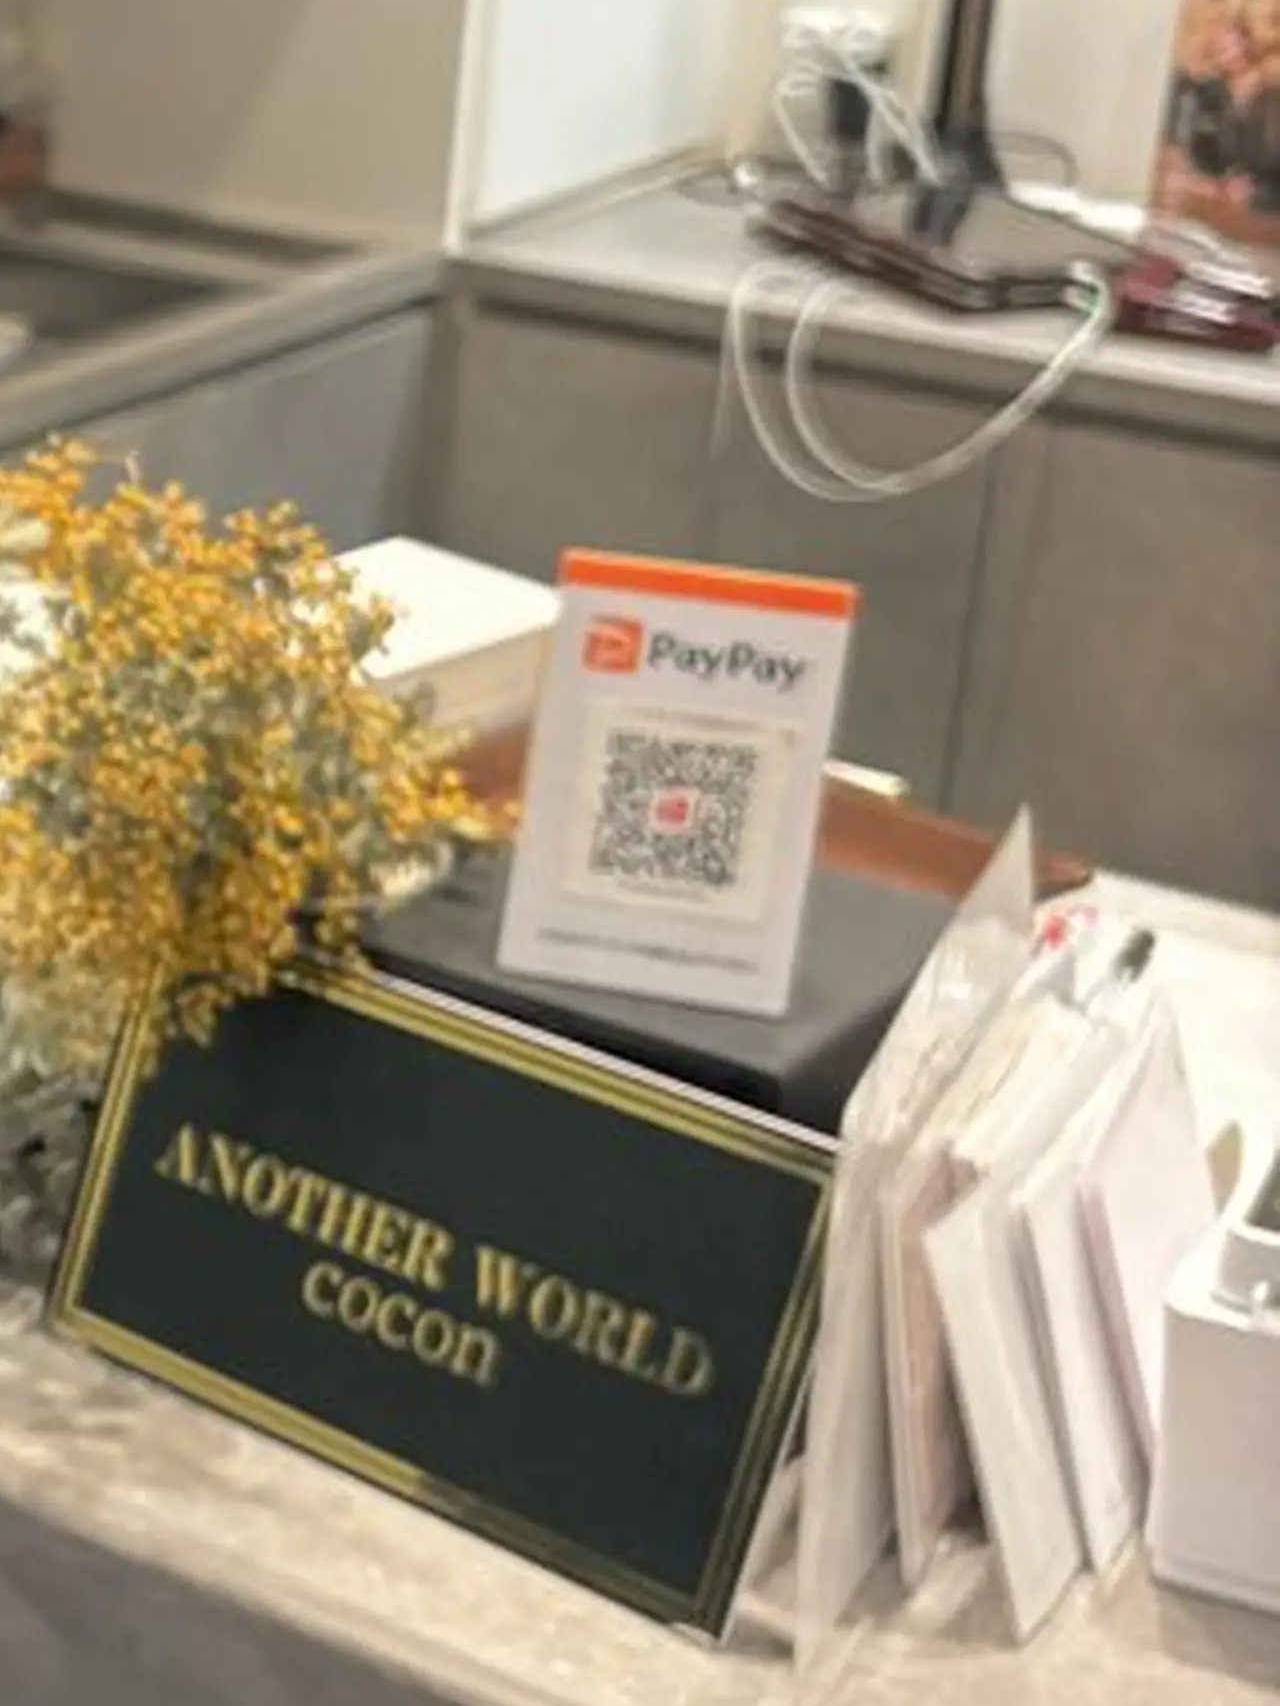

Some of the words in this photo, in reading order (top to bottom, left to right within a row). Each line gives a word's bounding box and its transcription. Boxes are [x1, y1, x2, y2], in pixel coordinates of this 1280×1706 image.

[646, 628, 808, 695] PayPay
[153, 1121, 454, 1291] ANOTHER
[476, 1245, 713, 1397] WORLD
